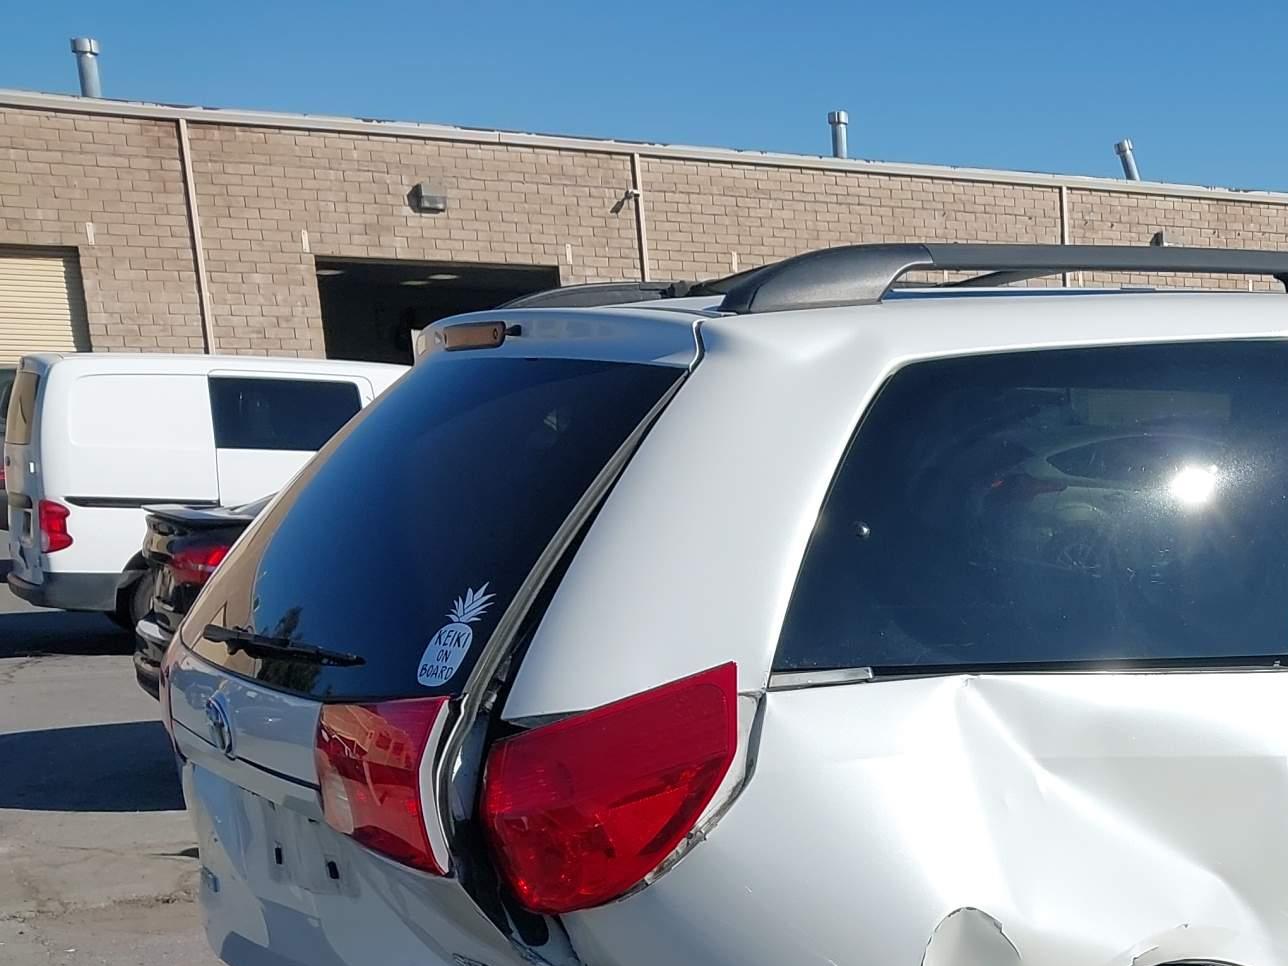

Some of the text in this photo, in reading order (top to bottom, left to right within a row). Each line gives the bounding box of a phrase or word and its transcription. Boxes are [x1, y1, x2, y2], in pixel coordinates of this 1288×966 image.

[434, 629, 471, 648] KEIKI
[437, 649, 451, 663] ON
[420, 664, 454, 680] BOARD
